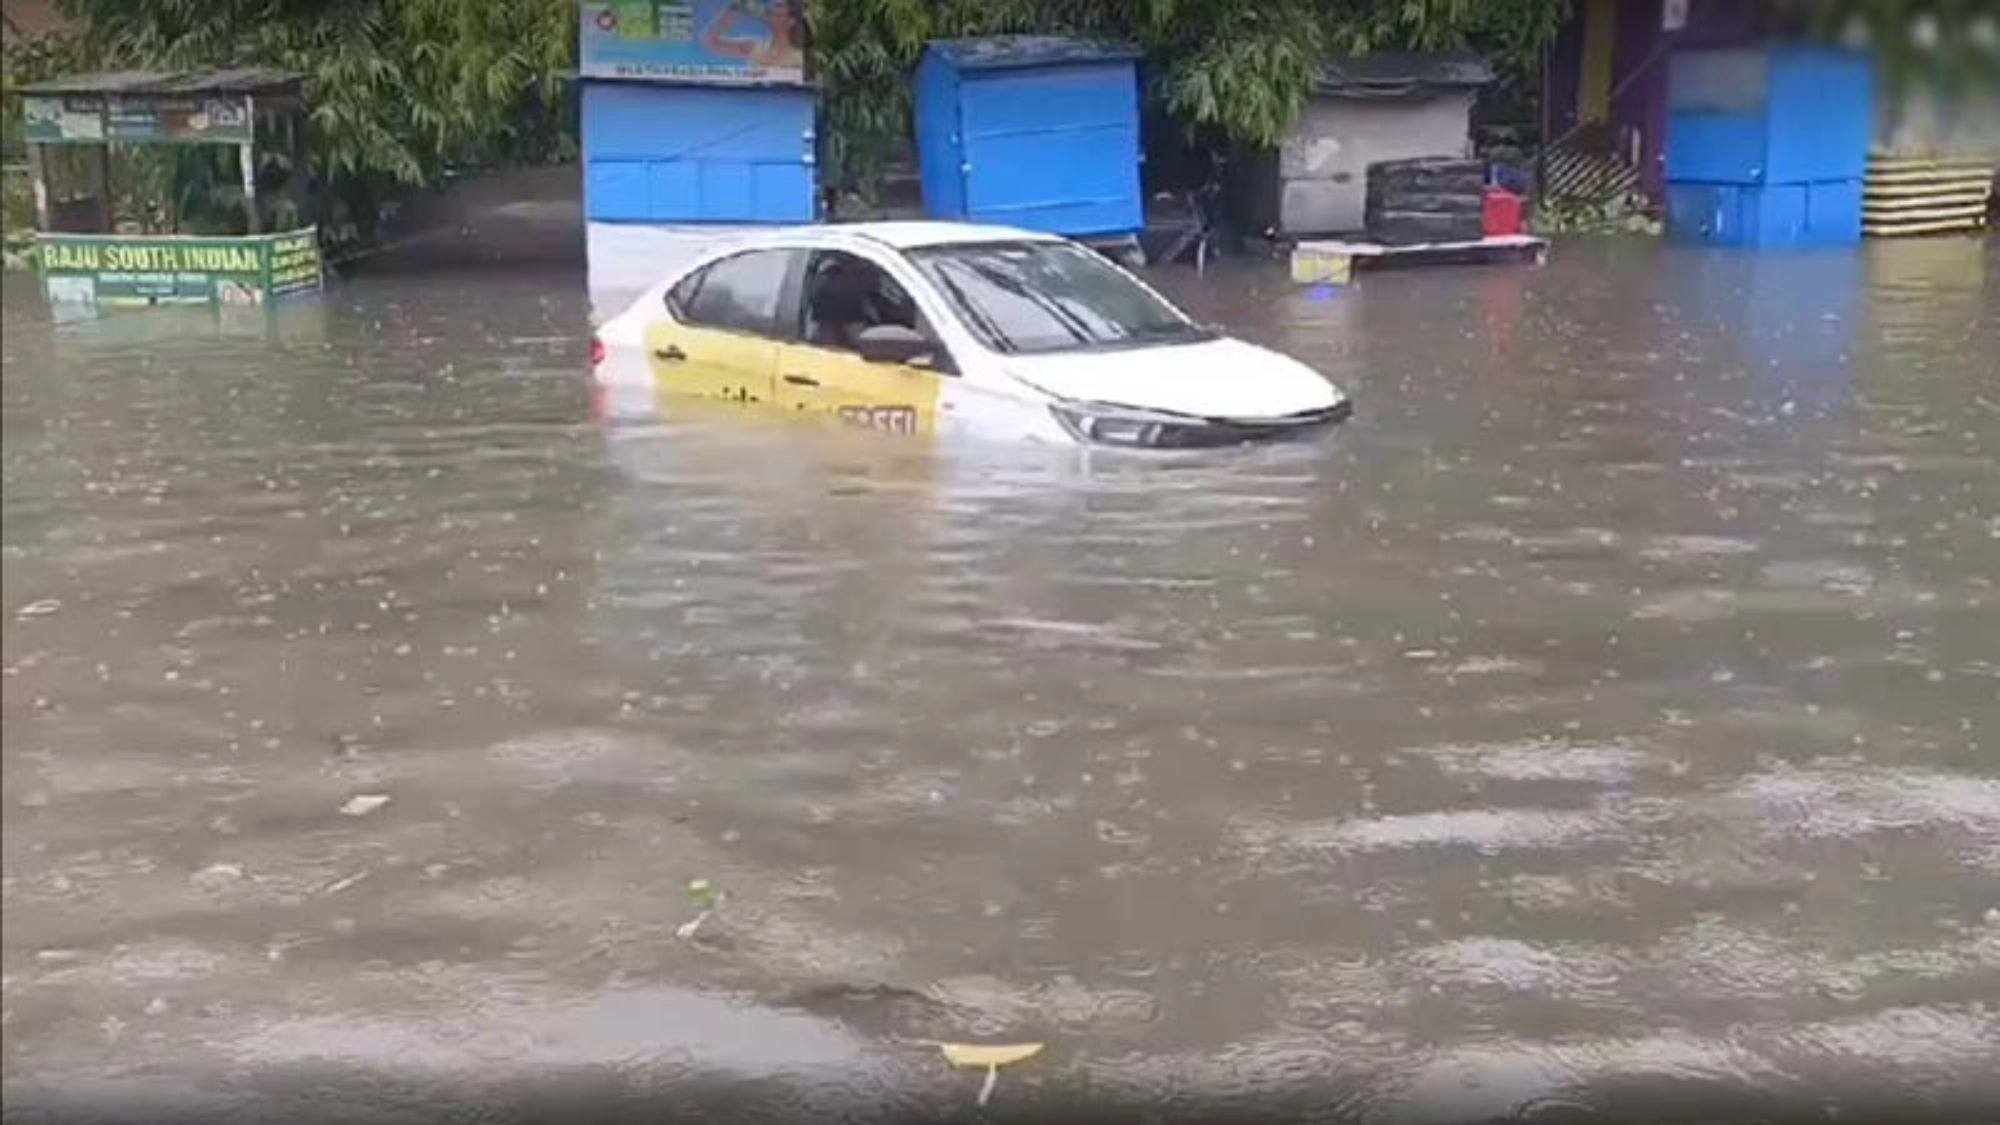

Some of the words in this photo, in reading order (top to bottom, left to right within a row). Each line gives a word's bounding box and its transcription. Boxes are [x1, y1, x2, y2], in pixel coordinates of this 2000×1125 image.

[44, 245, 98, 269] RAJU
[104, 246, 178, 270] SOUTH
[185, 247, 260, 271] INDIAN
